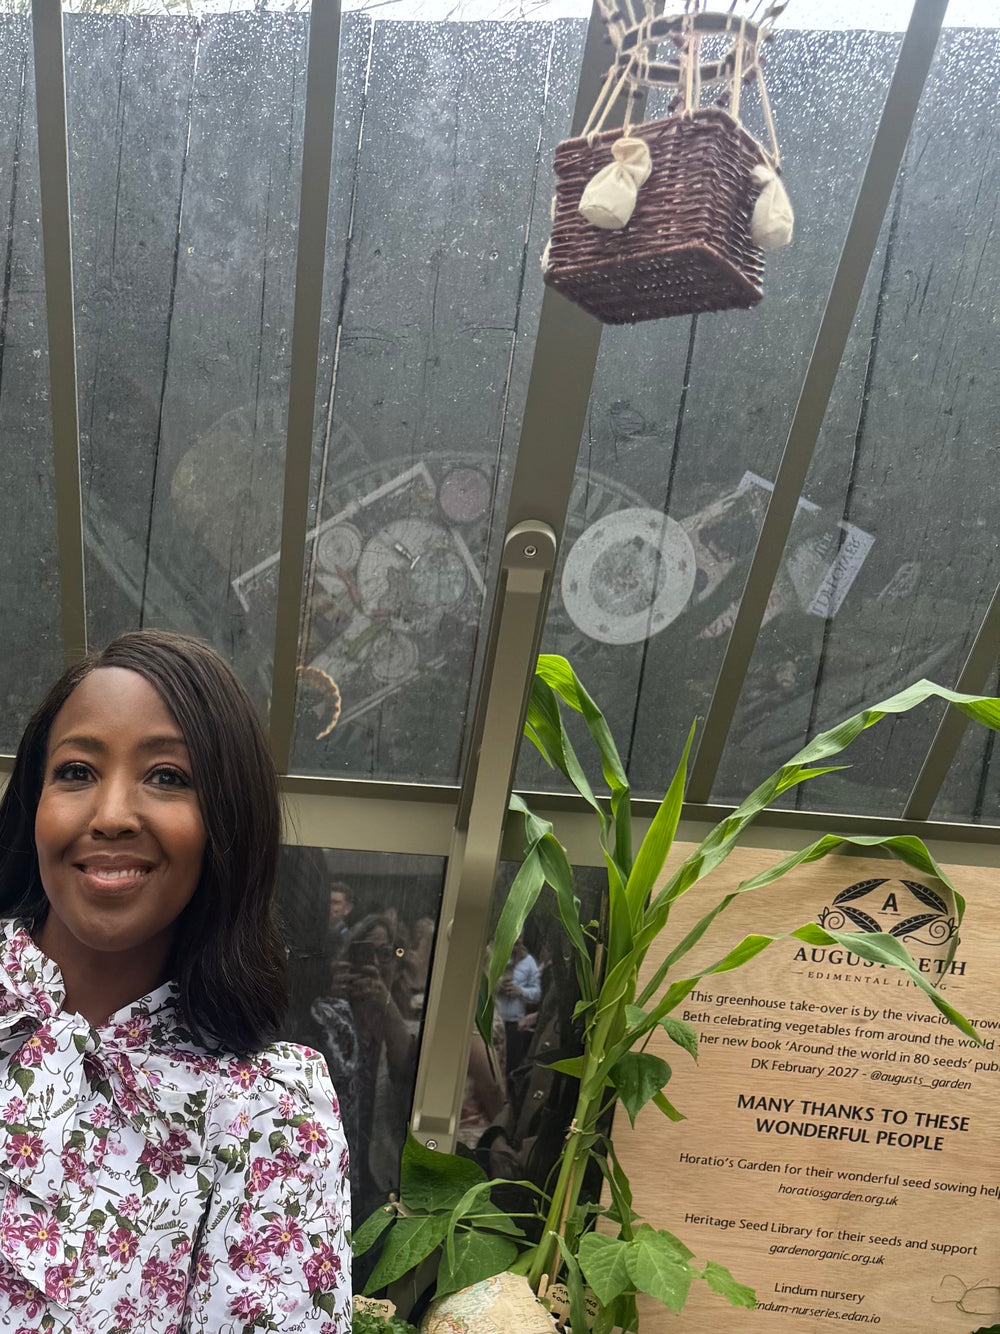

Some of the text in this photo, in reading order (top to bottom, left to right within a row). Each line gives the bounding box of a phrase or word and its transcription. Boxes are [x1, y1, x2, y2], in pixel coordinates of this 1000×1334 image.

[881, 893, 898, 912] A
[808, 972, 889, 985] EDIMENTAL
[690, 990, 713, 1002] This
[716, 994, 786, 1009] greenhouse
[790, 1000, 848, 1015] take-over
[851, 1005, 860, 1016] is
[863, 1006, 879, 1020] by
[883, 1008, 903, 1020] the
[906, 1011, 954, 1026] vivacio
[683, 1010, 710, 1023] Beth
[713, 1015, 782, 1032] celebrating
[785, 1021, 851, 1036] vegetables
[855, 1026, 884, 1039] from
[887, 1032, 931, 1044] around
[934, 1035, 954, 1046] the
[700, 1033, 719, 1044] her
[722, 1037, 748, 1047] new
[751, 1037, 781, 1050] book
[785, 1040, 834, 1055] 'Around
[837, 1046, 857, 1057] the
[860, 1049, 896, 1062] world
[900, 1052, 910, 1063] in
[913, 1053, 930, 1065] 80
[974, 1061, 1000, 1072] pub
[751, 1058, 769, 1070] DK
[771, 1060, 825, 1077] February
[827, 1066, 859, 1078] 2027
[737, 1094, 970, 1132] MANY THANKS TO THESE
[756, 1118, 945, 1151] WONDERFUL PEOPLE
[679, 1152, 734, 1168] Horatio's
[737, 1158, 781, 1173] Garden
[784, 1163, 802, 1175] for
[805, 1166, 834, 1178] their
[837, 1169, 900, 1186] wonderful
[902, 1177, 932, 1189] seed
[934, 1181, 978, 1197] sowing
[778, 1183, 899, 1206] horatiosgarden.org.uk
[684, 1213, 978, 1256] Heritage Seed Library for their seeds and support
[768, 1244, 886, 1266] gardenorganic.org.uk
[774, 1282, 865, 1305] Lindum nursery
[754, 1300, 881, 1324] indum-nurseries.edan.io
